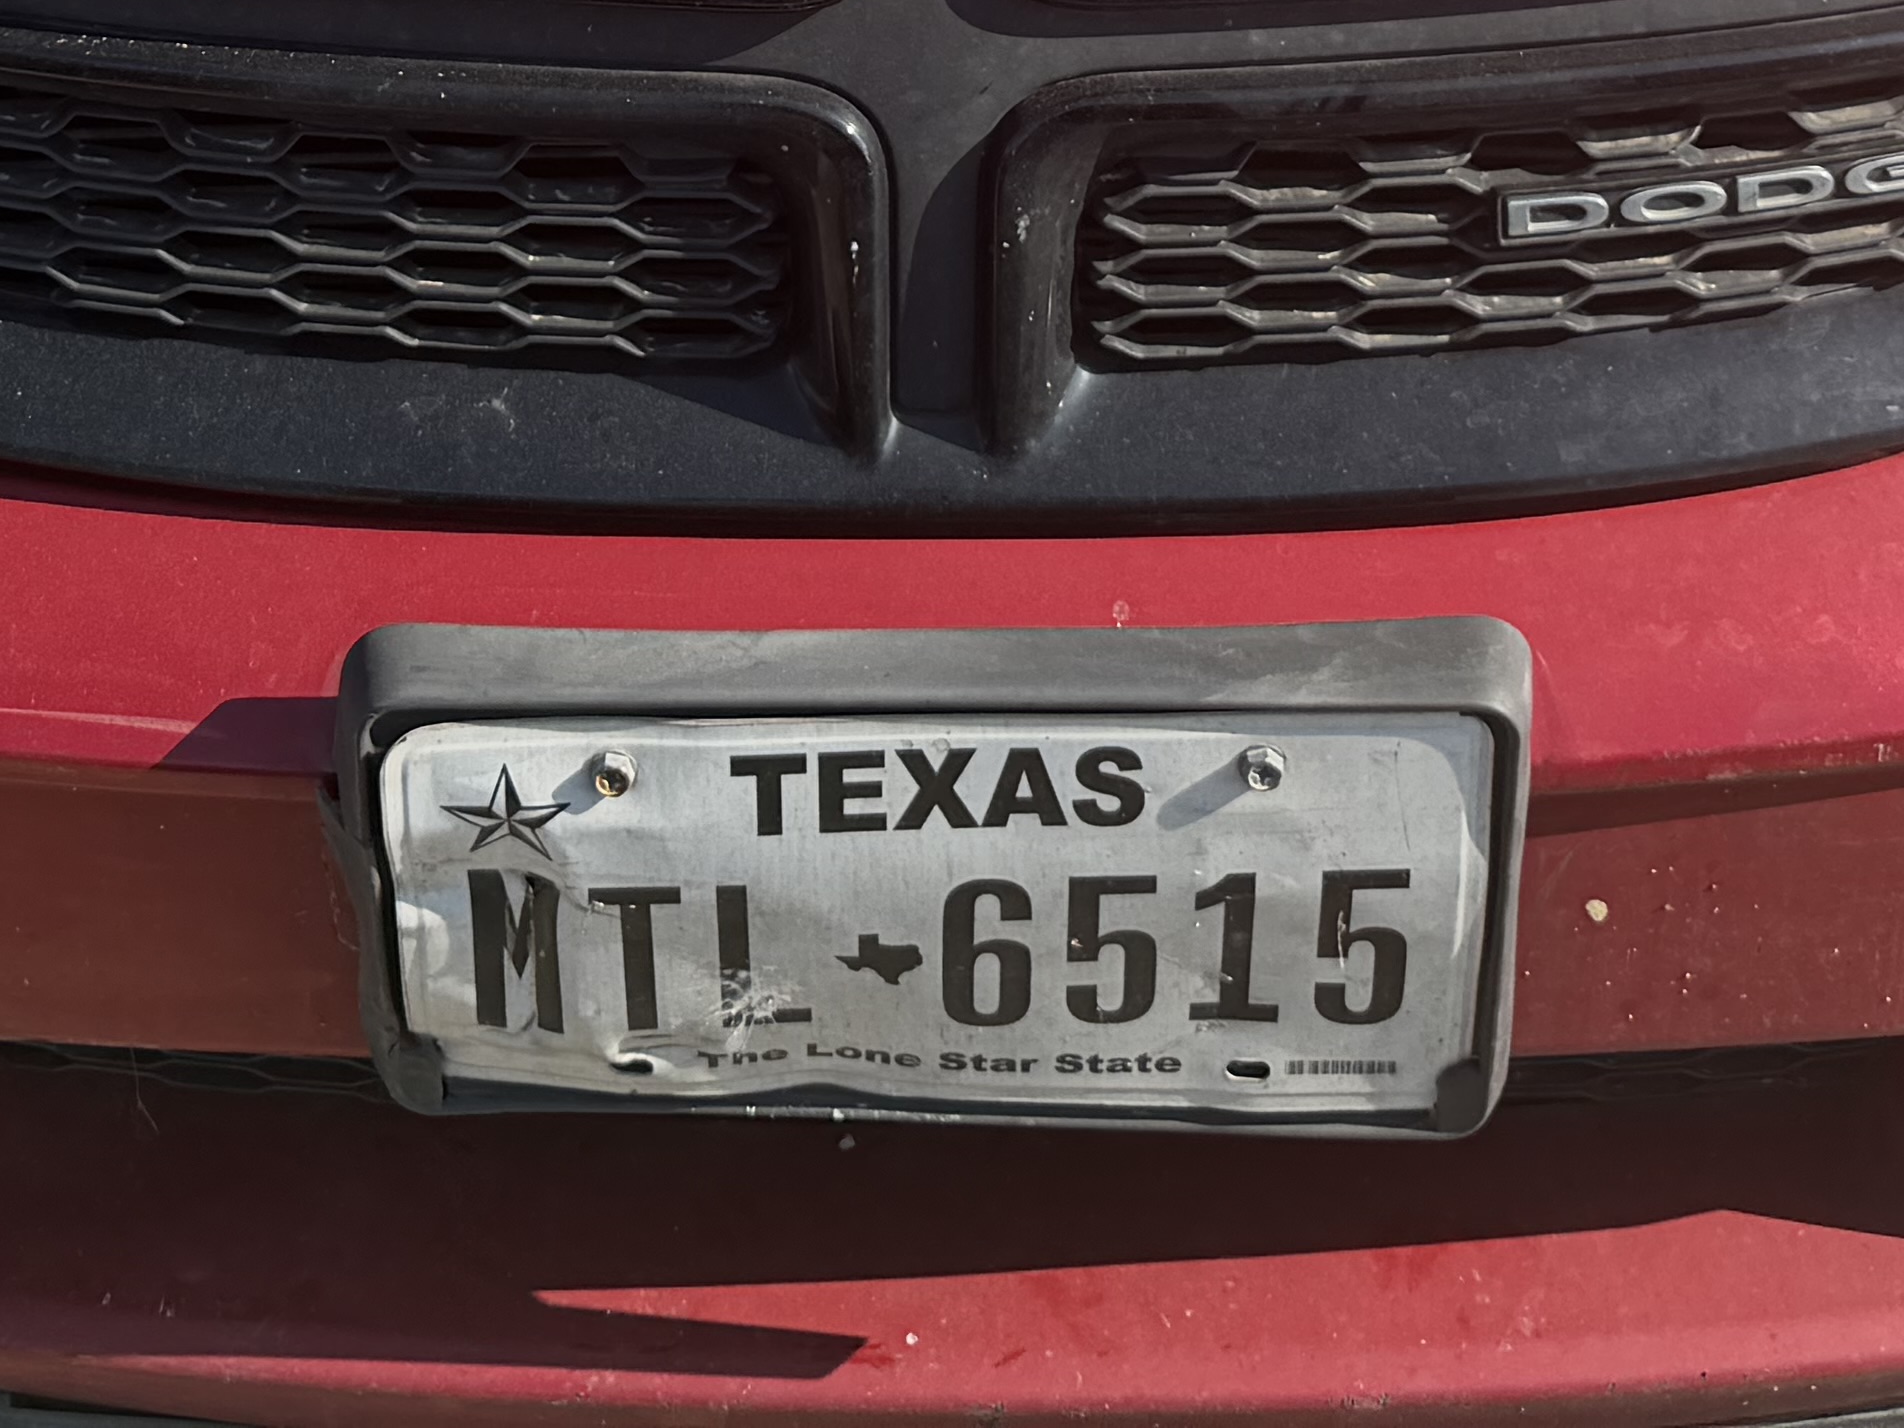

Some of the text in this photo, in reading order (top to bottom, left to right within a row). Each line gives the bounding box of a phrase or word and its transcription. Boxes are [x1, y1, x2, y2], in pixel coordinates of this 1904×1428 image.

[728, 745, 1147, 837] TEXAS
[466, 868, 1413, 1035] MTL 6515
[697, 1042, 1182, 1074] The Lone Star State
